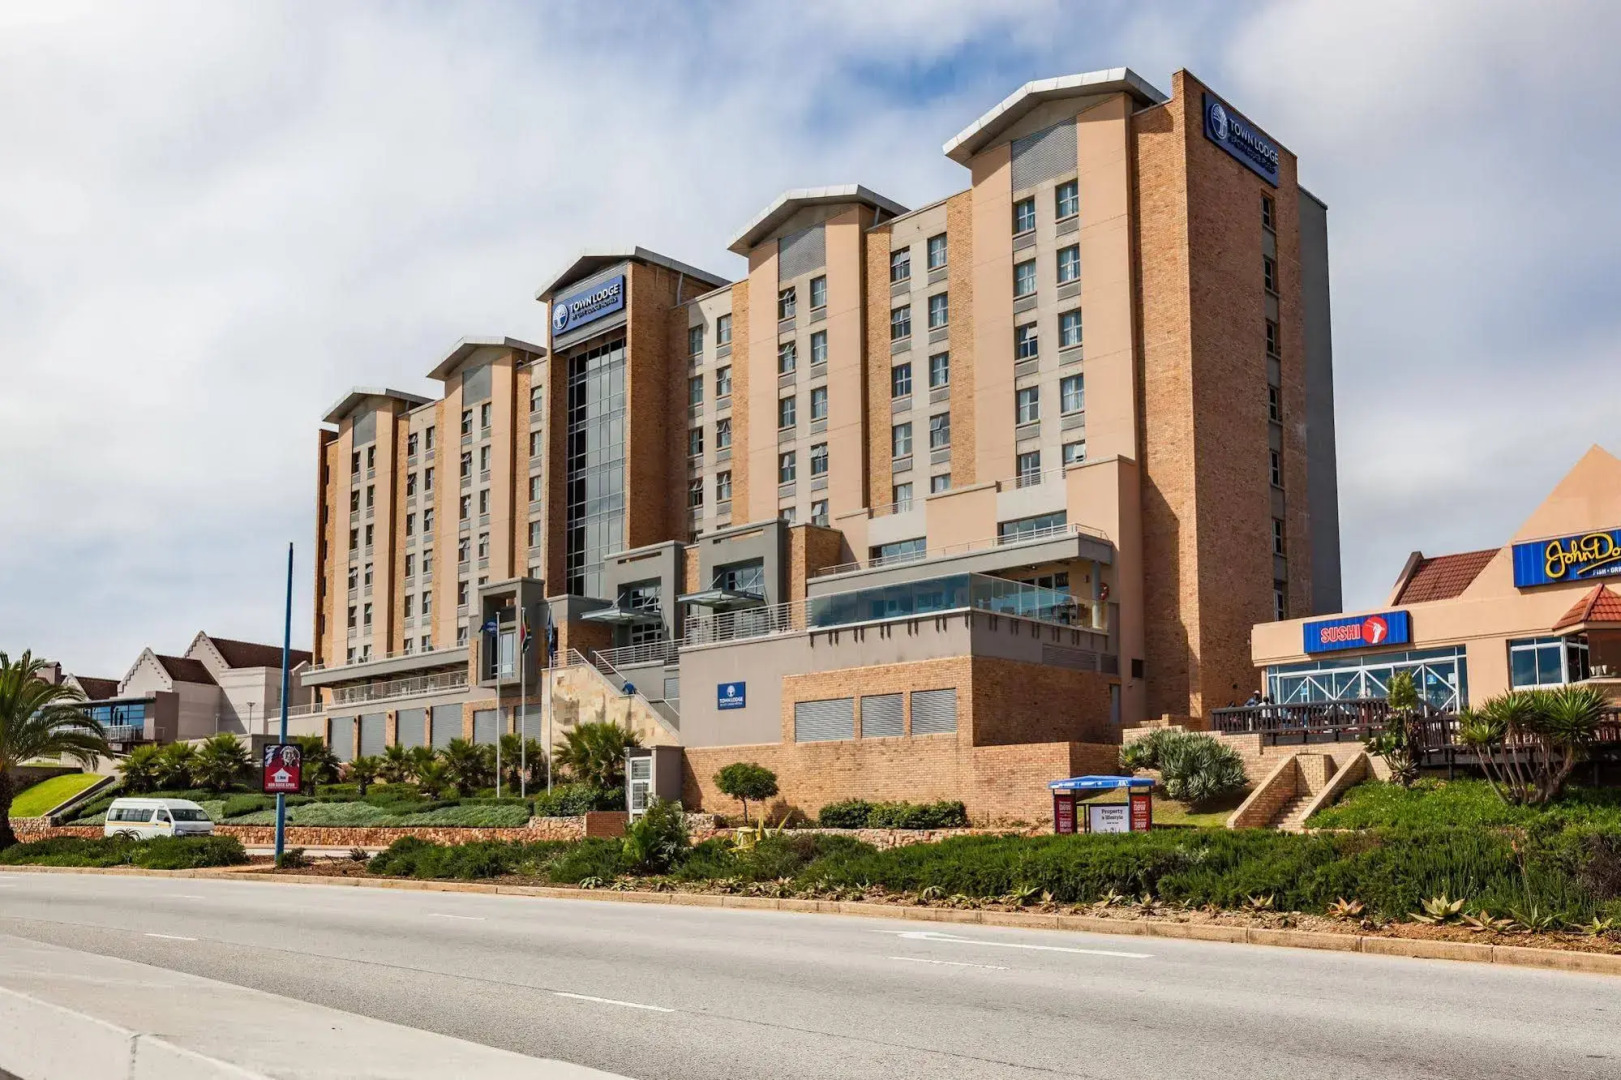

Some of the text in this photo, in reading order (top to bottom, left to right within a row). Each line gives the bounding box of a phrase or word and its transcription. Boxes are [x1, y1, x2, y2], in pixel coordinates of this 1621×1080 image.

[1229, 118, 1254, 146] TOWN
[1254, 137, 1279, 166] LODGE
[569, 295, 592, 313] TOWN
[592, 283, 619, 303] LODGE
[1545, 532, 1621, 579] John Do
[1320, 624, 1360, 643] SUSHI
